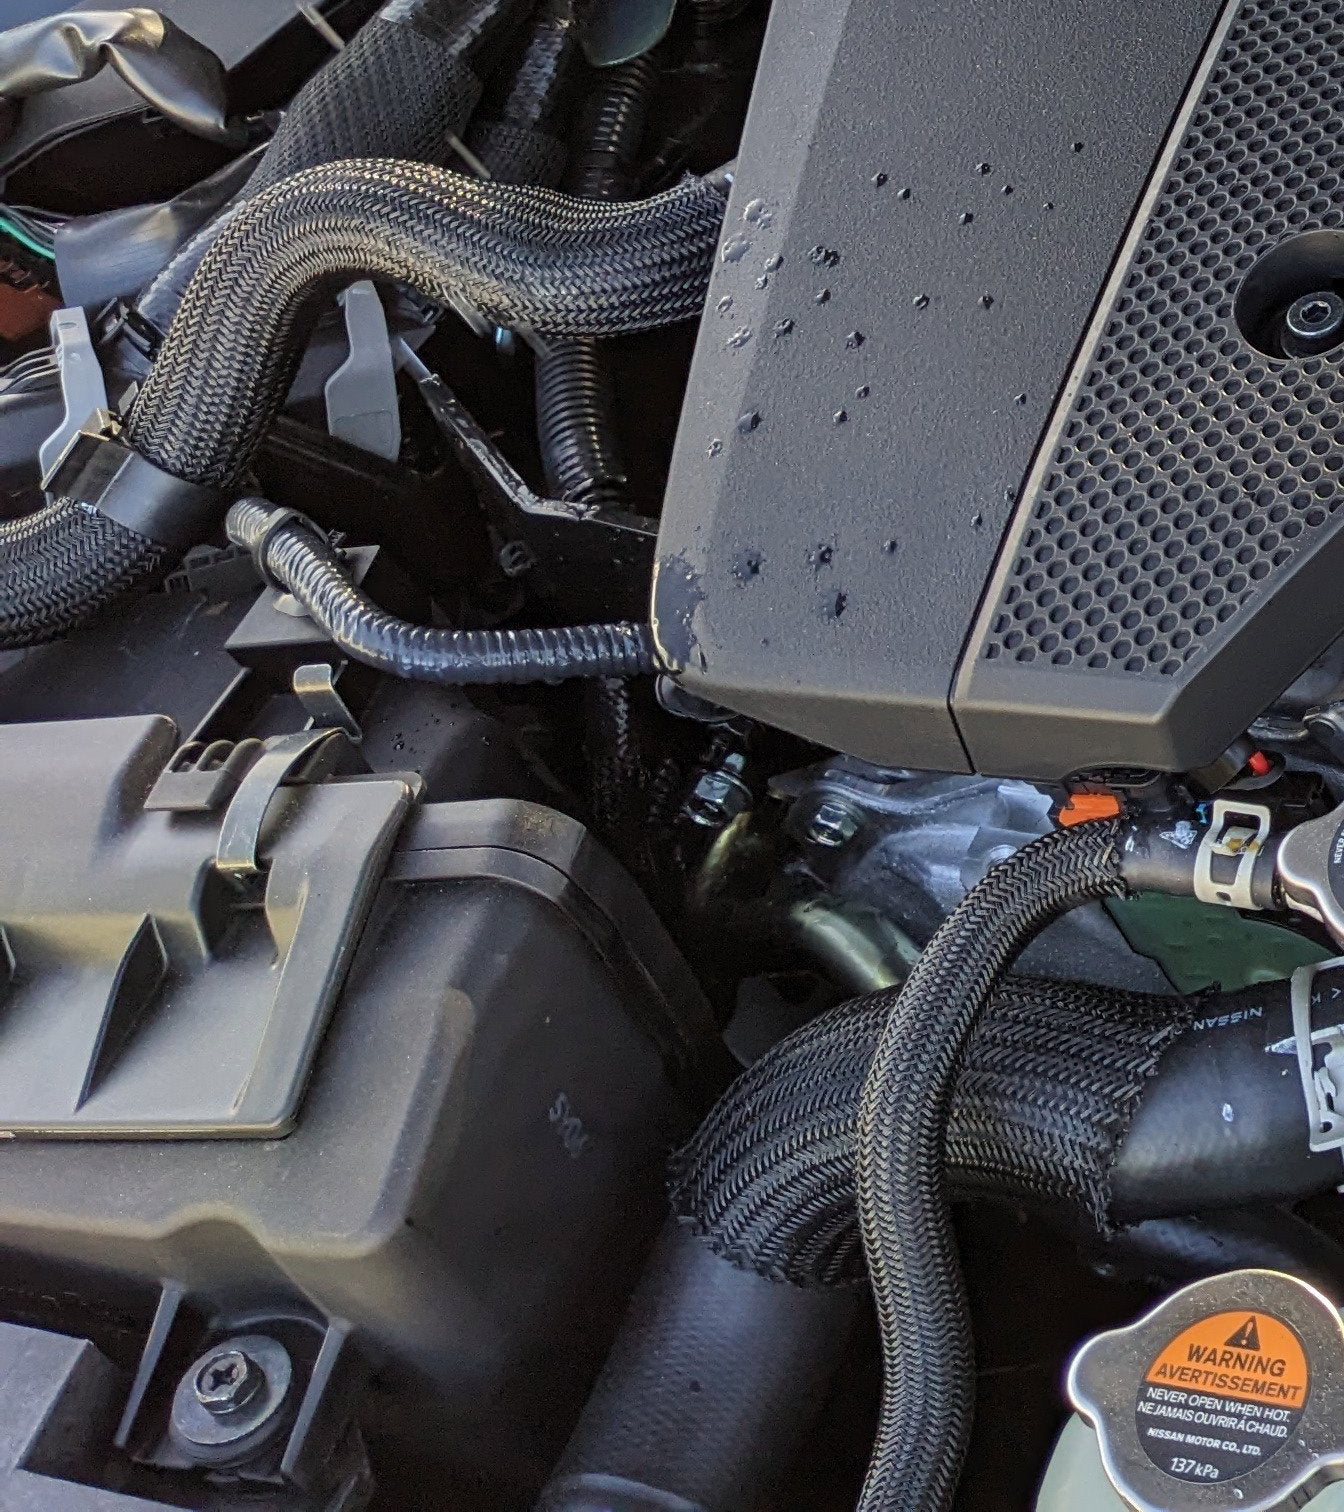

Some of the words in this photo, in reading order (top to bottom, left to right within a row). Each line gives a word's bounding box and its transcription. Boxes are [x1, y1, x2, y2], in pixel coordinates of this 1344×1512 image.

[1193, 1006, 1263, 1031] NISSAN
[1187, 1343, 1287, 1377] WARNING
[1155, 1363, 1302, 1400] AVERTISSEMENT
[1137, 1400, 1153, 1414] NE
[1152, 1404, 1193, 1422] JAMAIS
[1194, 1412, 1238, 1428] OUVRIR
[1246, 1420, 1288, 1438] CHAUD.
[1146, 1387, 1188, 1404] NEVER
[1188, 1394, 1223, 1411] OPEN
[1224, 1401, 1263, 1418] WHEN
[1263, 1408, 1291, 1422] HOT.
[1147, 1427, 1185, 1442] NISSAN
[1185, 1433, 1221, 1449] MOTOR
[1242, 1445, 1262, 1456] LTD.
